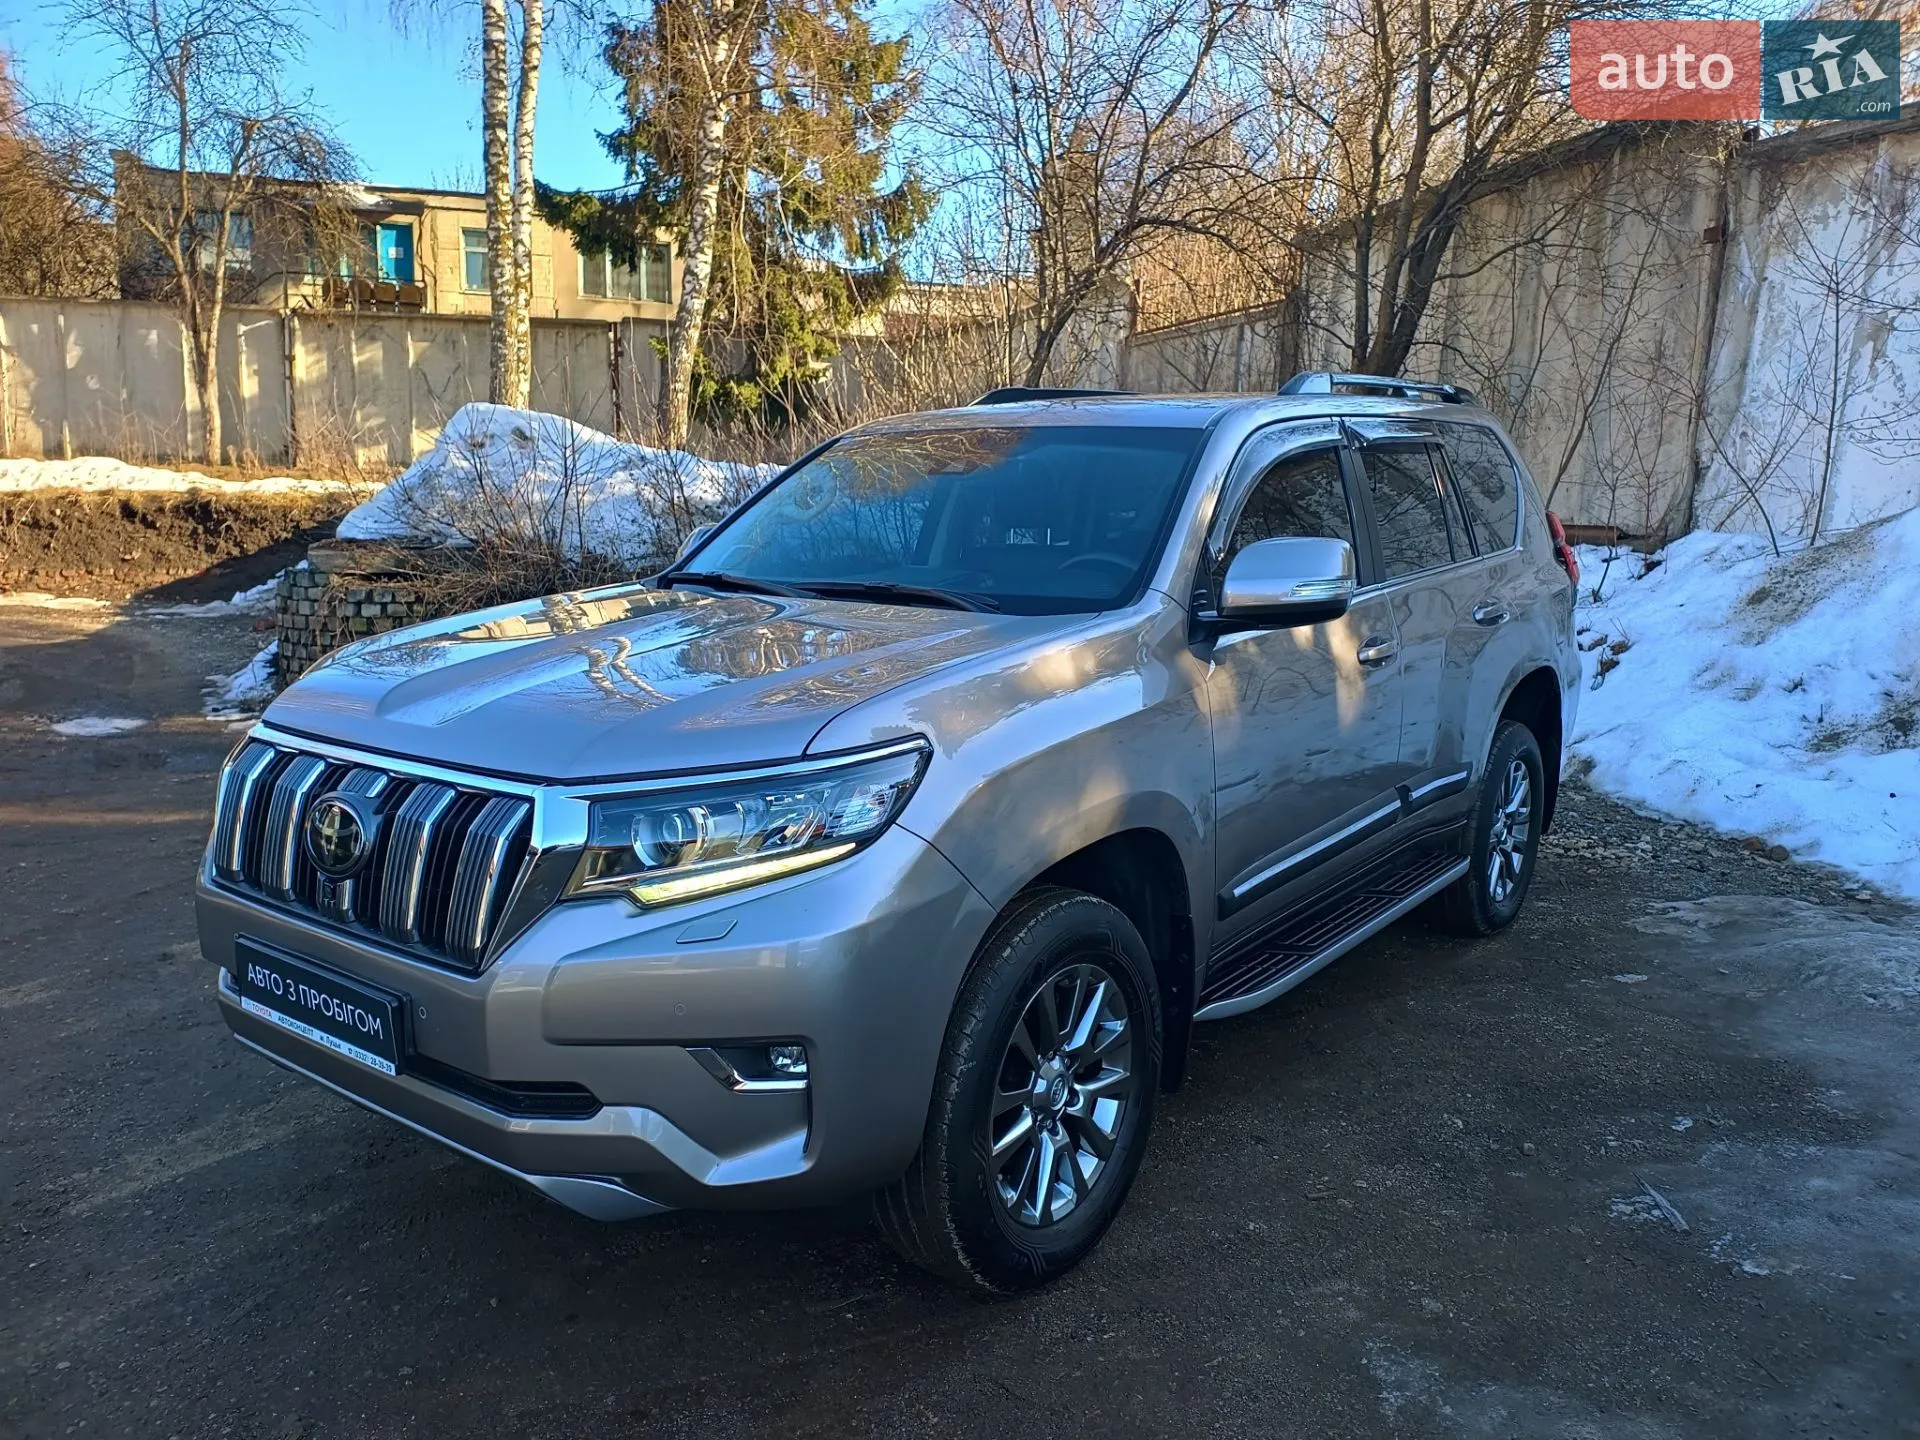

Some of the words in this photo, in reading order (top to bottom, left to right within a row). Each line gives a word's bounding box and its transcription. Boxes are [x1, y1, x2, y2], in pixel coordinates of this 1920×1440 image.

[247, 962, 283, 995] АВТО
[299, 984, 384, 1040] ПРОБІГОМ
[251, 1003, 272, 1019] TOYOTA
